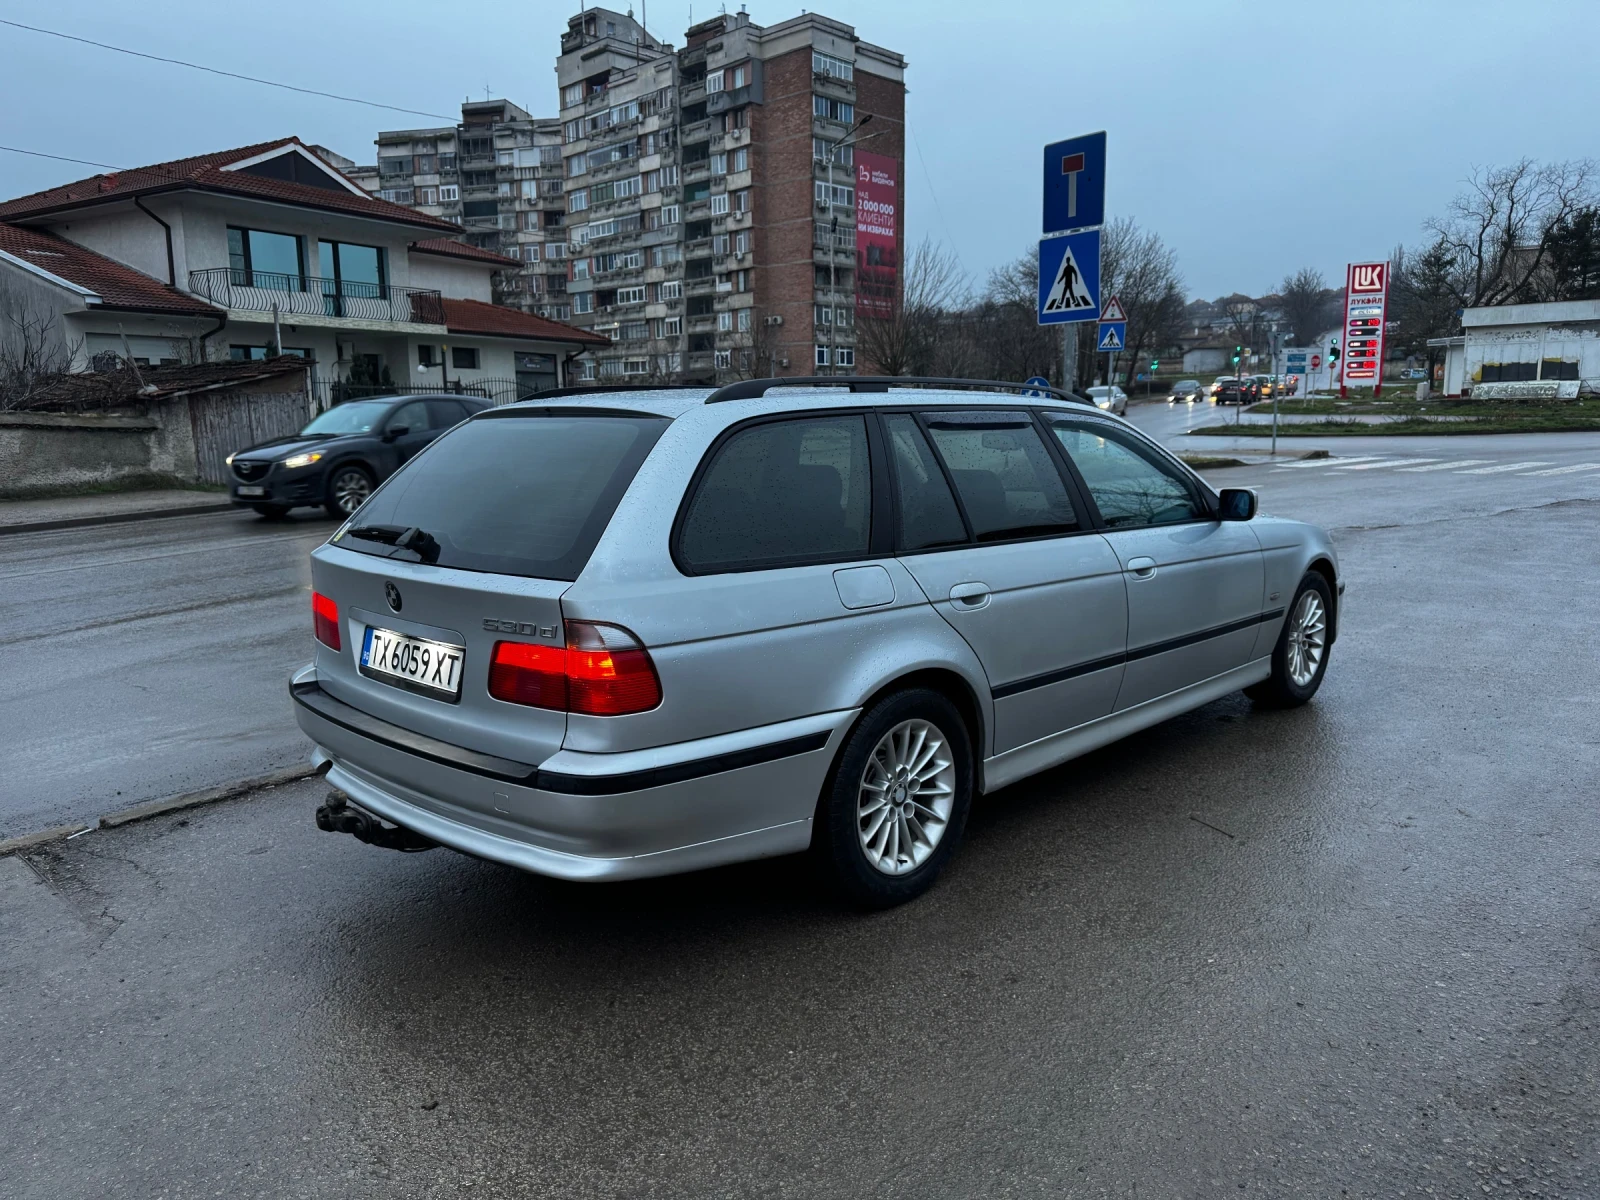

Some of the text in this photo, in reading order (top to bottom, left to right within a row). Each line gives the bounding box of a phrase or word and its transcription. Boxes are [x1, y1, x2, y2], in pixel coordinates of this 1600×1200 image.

[858, 191, 869, 199] НАД
[857, 211, 894, 227] КЛИЕНТИ
[858, 223, 867, 233] НИ
[1350, 296, 1383, 305] ЛУКОЙЛ
